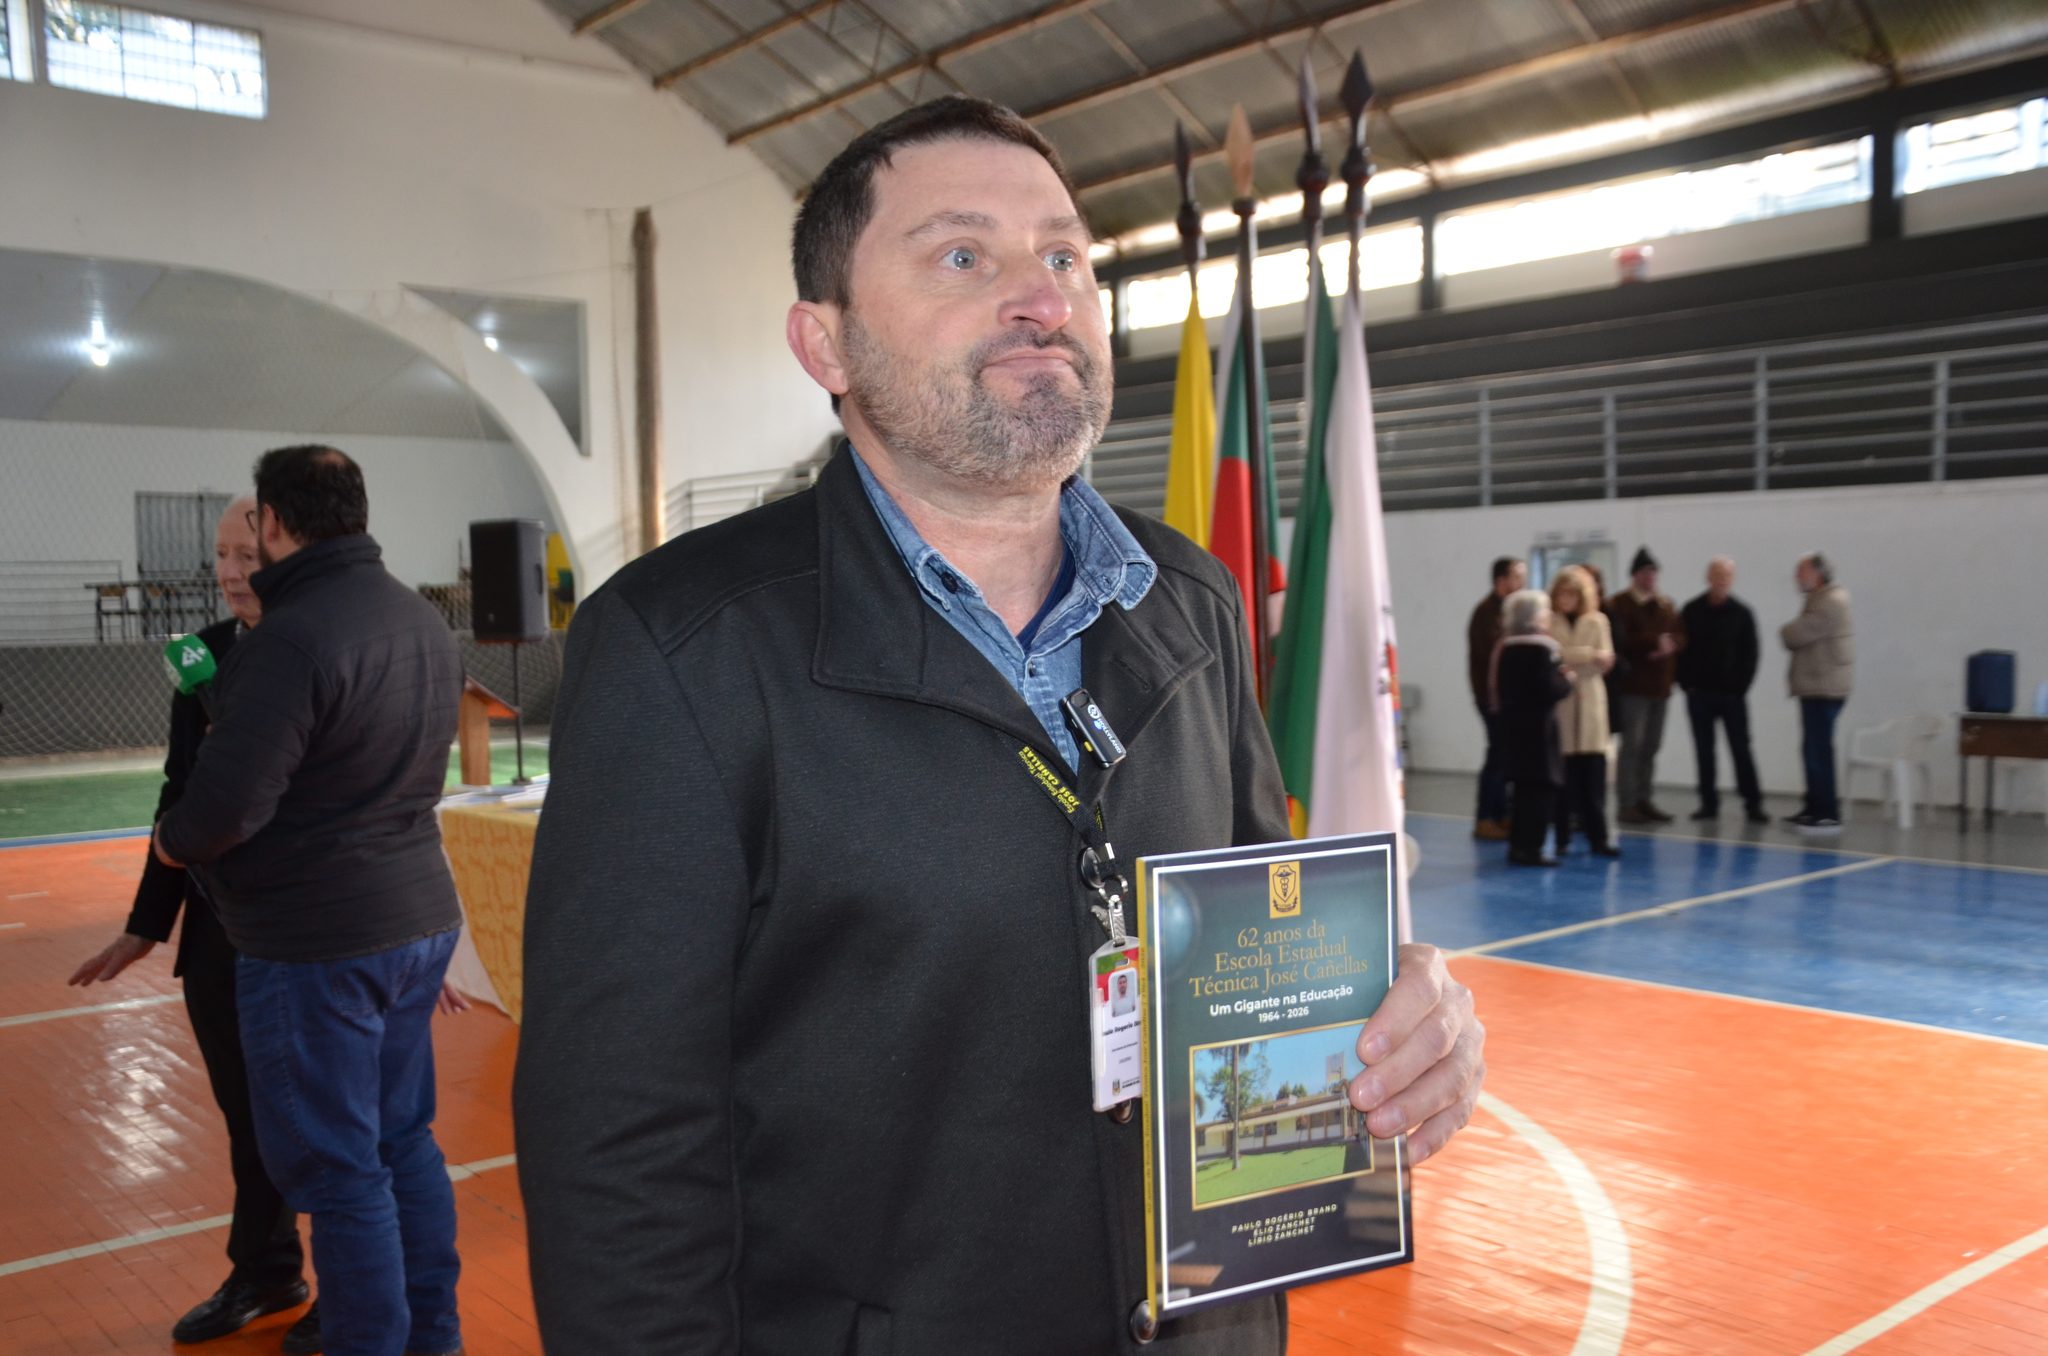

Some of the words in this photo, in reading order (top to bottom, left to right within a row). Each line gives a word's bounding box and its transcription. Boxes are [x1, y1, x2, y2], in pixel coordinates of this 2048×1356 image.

[1034, 772, 1059, 796] Estadual
[1057, 795, 1075, 814] Escola
[1236, 927, 1259, 948] 62
[1263, 927, 1301, 945] anos
[1306, 919, 1326, 939] da
[1215, 948, 1272, 972] Escola
[1279, 936, 1347, 963] Estadual
[1188, 972, 1259, 998] Técnica
[1262, 964, 1298, 994] José
[1303, 956, 1369, 981] Cañellas
[1209, 1004, 1232, 1017] Um
[1233, 996, 1280, 1015] Gigante
[1282, 993, 1297, 1005] na
[1299, 985, 1353, 1002] Educação
[1258, 1011, 1280, 1023] 1964
[1287, 1006, 1309, 1019] 2026
[1231, 1220, 1261, 1234] PAULO
[1307, 1203, 1337, 1216] BRAND
[1275, 1216, 1315, 1232] ZANCHET
[1274, 1225, 1315, 1241] ZANCHET
